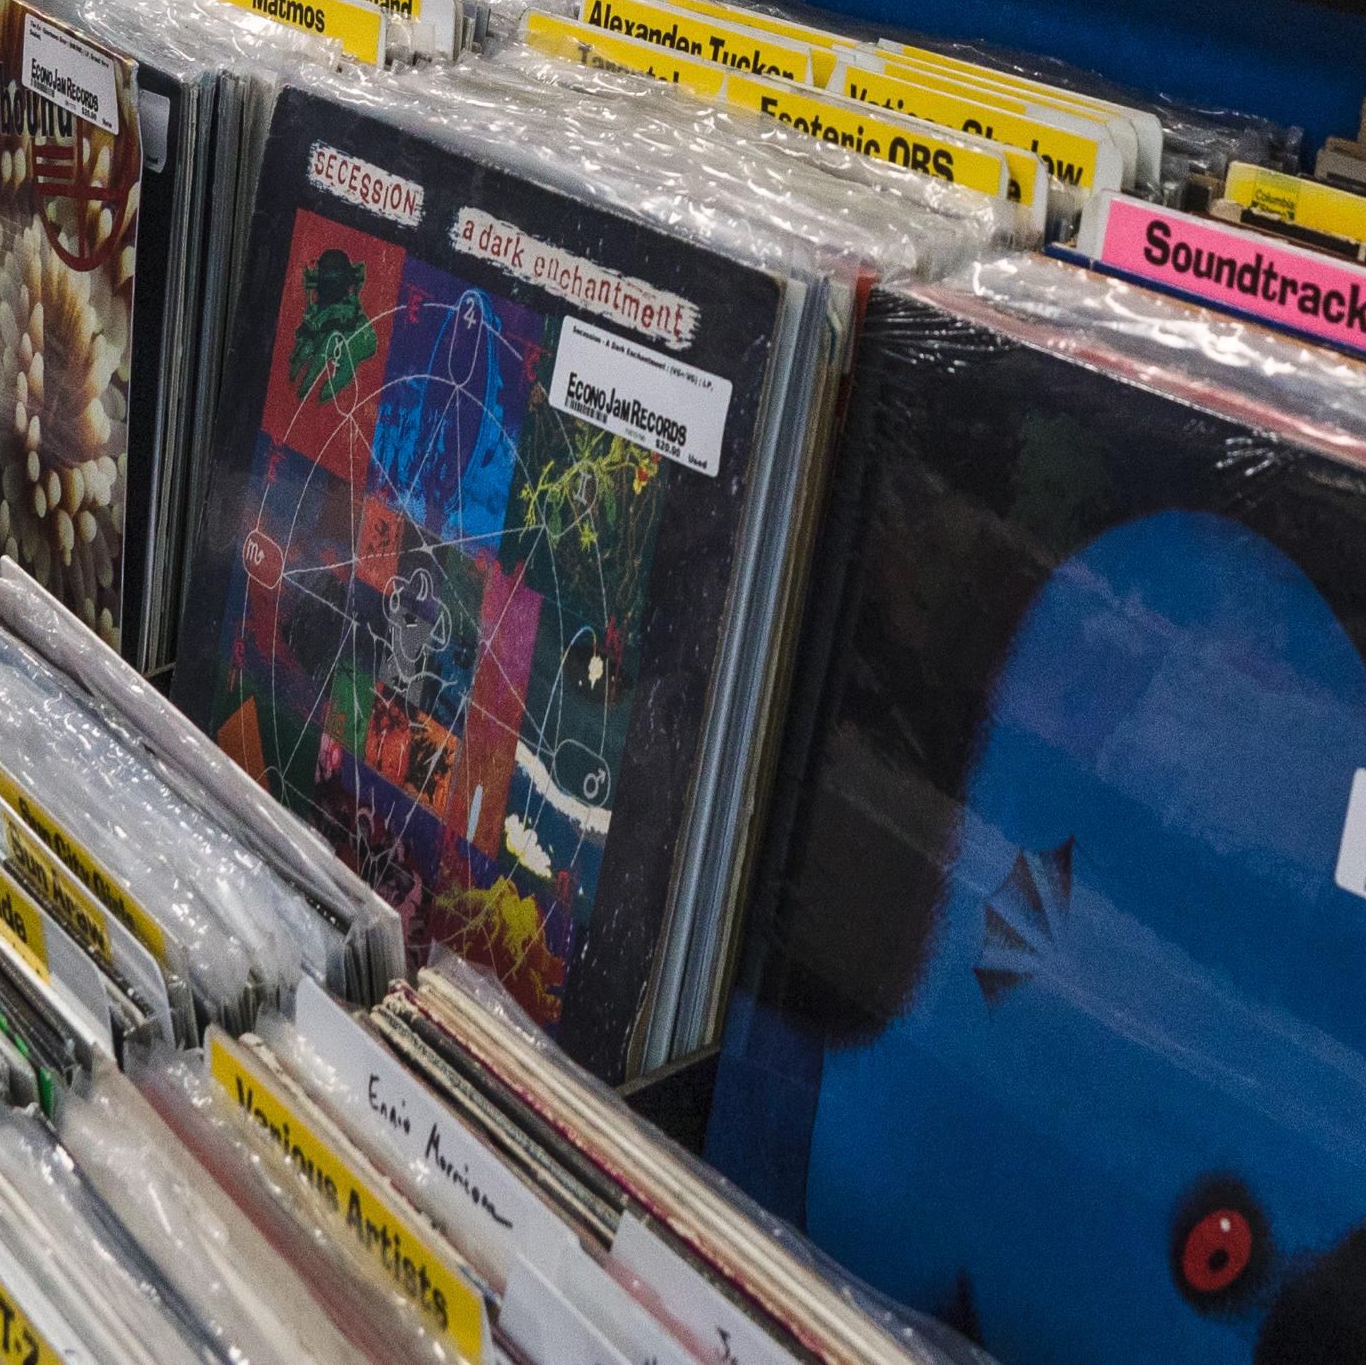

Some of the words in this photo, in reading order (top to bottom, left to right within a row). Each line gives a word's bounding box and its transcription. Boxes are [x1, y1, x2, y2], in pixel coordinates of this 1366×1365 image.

[588, 0, 704, 57] Alexander
[708, 36, 795, 81] Tucker
[760, 95, 882, 160] Esoteric
[312, 148, 418, 218] SECESSION
[462, 215, 476, 242] a
[478, 222, 524, 269] dark
[534, 255, 685, 339] enchantment
[687, 452, 709, 470] Used
[17, 794, 51, 847] Sun
[54, 827, 89, 885] City
[7, 818, 48, 883] Sun
[50, 860, 108, 954] Araw
[236, 1076, 339, 1214] Various
[345, 1192, 449, 1334] Artists
